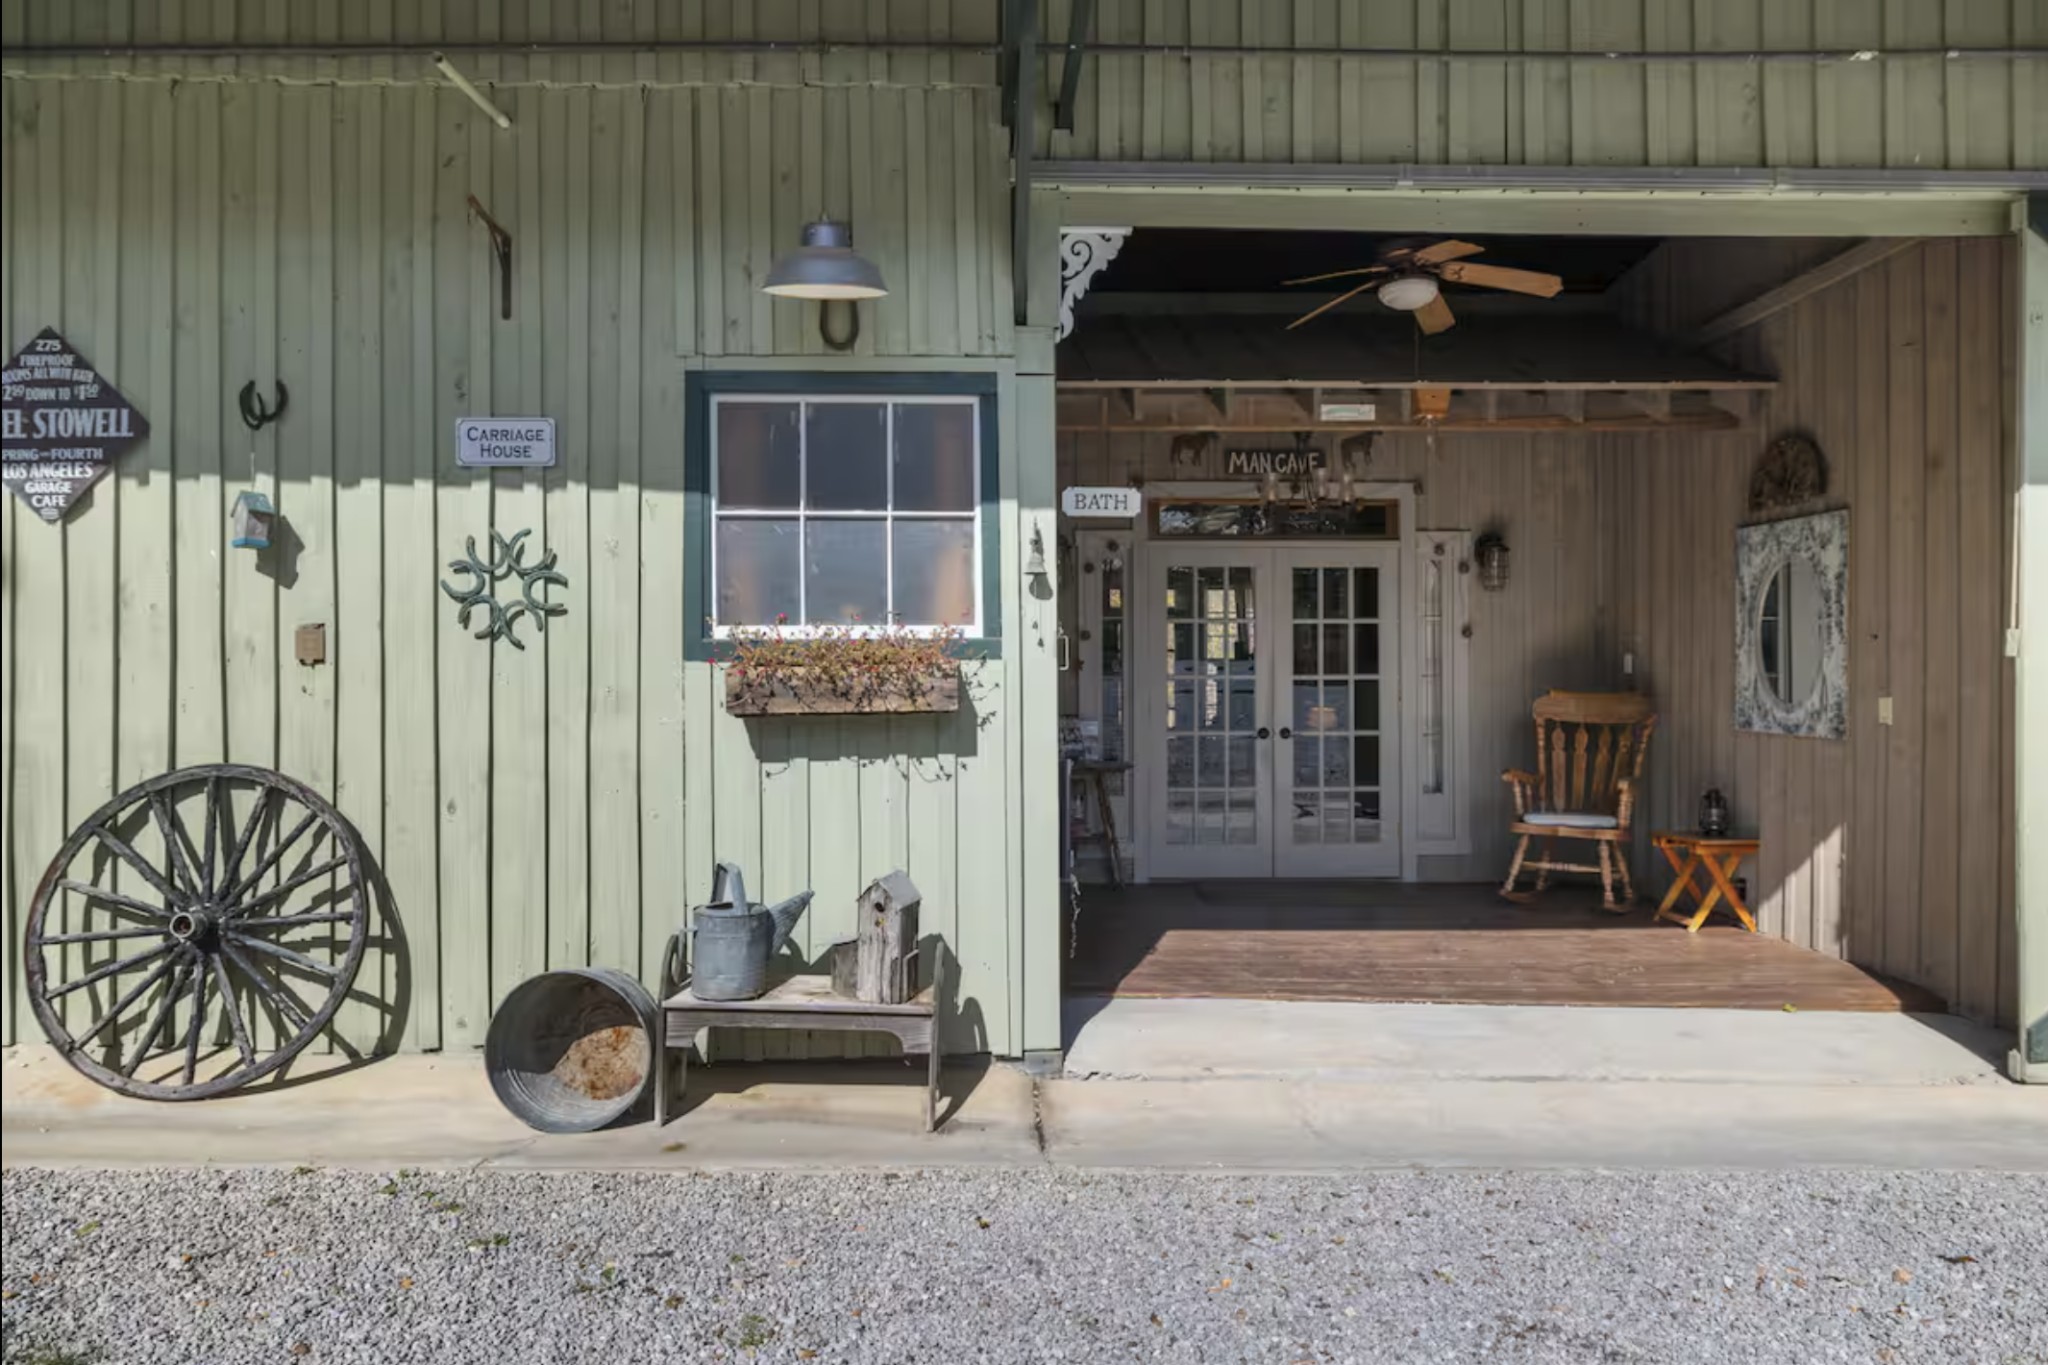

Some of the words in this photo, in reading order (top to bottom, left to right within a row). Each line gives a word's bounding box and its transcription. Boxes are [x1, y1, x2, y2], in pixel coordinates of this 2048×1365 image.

[35, 339, 62, 352] 275
[20, 353, 76, 368] FIREPROOF
[32, 368, 49, 380] ALL
[50, 367, 73, 380] WITH
[72, 369, 95, 383] BATH
[26, 387, 56, 400] DOWN
[59, 387, 71, 400] TO
[33, 408, 134, 439] STOWELL
[466, 426, 545, 442] CARRIAGE
[480, 442, 532, 459] HOUSE
[2, 462, 27, 480] LOS
[29, 461, 94, 480] ANGELES
[24, 480, 72, 494] GARAGE
[31, 494, 67, 507] CAFE
[1073, 493, 1129, 511] BATH
